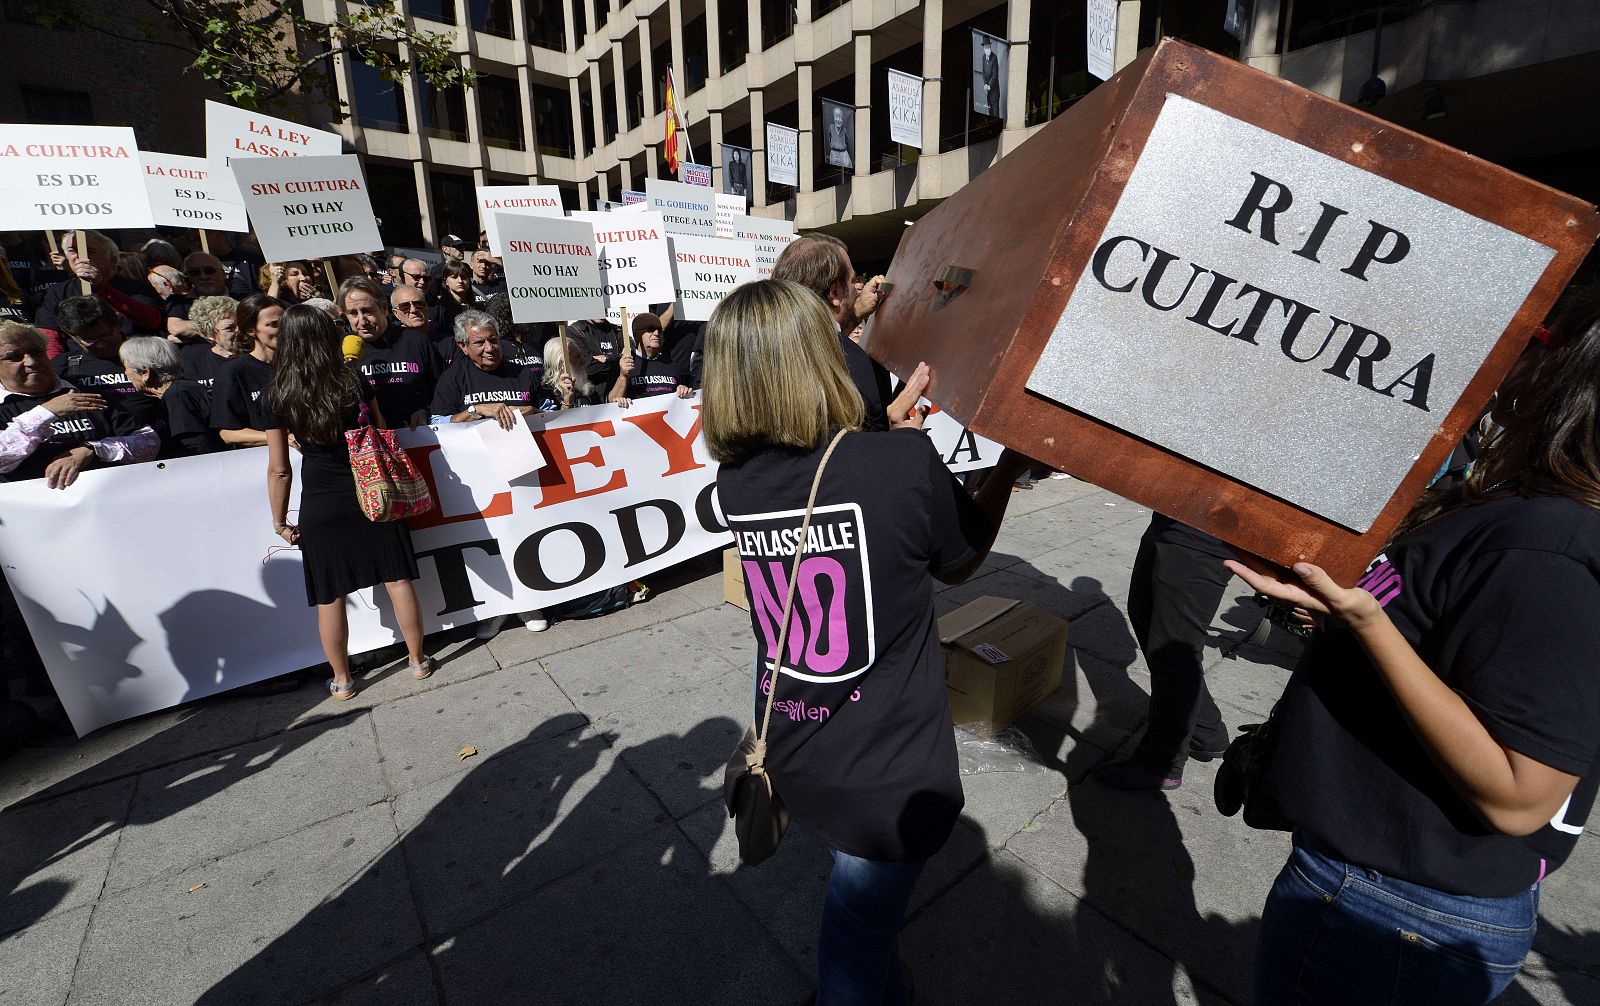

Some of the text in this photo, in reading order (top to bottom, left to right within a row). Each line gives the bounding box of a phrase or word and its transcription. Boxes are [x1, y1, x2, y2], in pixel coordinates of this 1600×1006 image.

[248, 120, 311, 146] LA LEY
[25, 144, 130, 158] CULTURA
[770, 152, 797, 169] KIKAI
[146, 165, 208, 180] LA CULT
[36, 174, 100, 187] ES DE
[251, 179, 360, 196] SIN CULTURA
[175, 188, 191, 199] ES
[34, 202, 113, 216] TODOS
[283, 201, 344, 216] NO HAY
[485, 198, 558, 209] LA CULTURA
[655, 198, 709, 212] EL GOBIERNO
[173, 208, 223, 221] TODOS
[663, 214, 690, 225] OTEGE
[699, 218, 713, 227] LAS
[286, 221, 354, 238] FUTURO
[594, 228, 659, 244] ULTURA
[737, 231, 746, 239] EL
[746, 232, 758, 240] IVA
[509, 240, 593, 257] SIN CULTURA
[616, 256, 638, 269] DE
[676, 252, 751, 268] SIN CULTURA
[533, 264, 579, 277] NO HAY
[695, 272, 738, 284] NO HAY
[511, 286, 603, 299] CONOCIMIENTO
[603, 281, 647, 296] ODOS
[1092, 235, 1437, 413] CULTURA
[403, 404, 707, 531] LEY
[741, 556, 849, 674] NO
